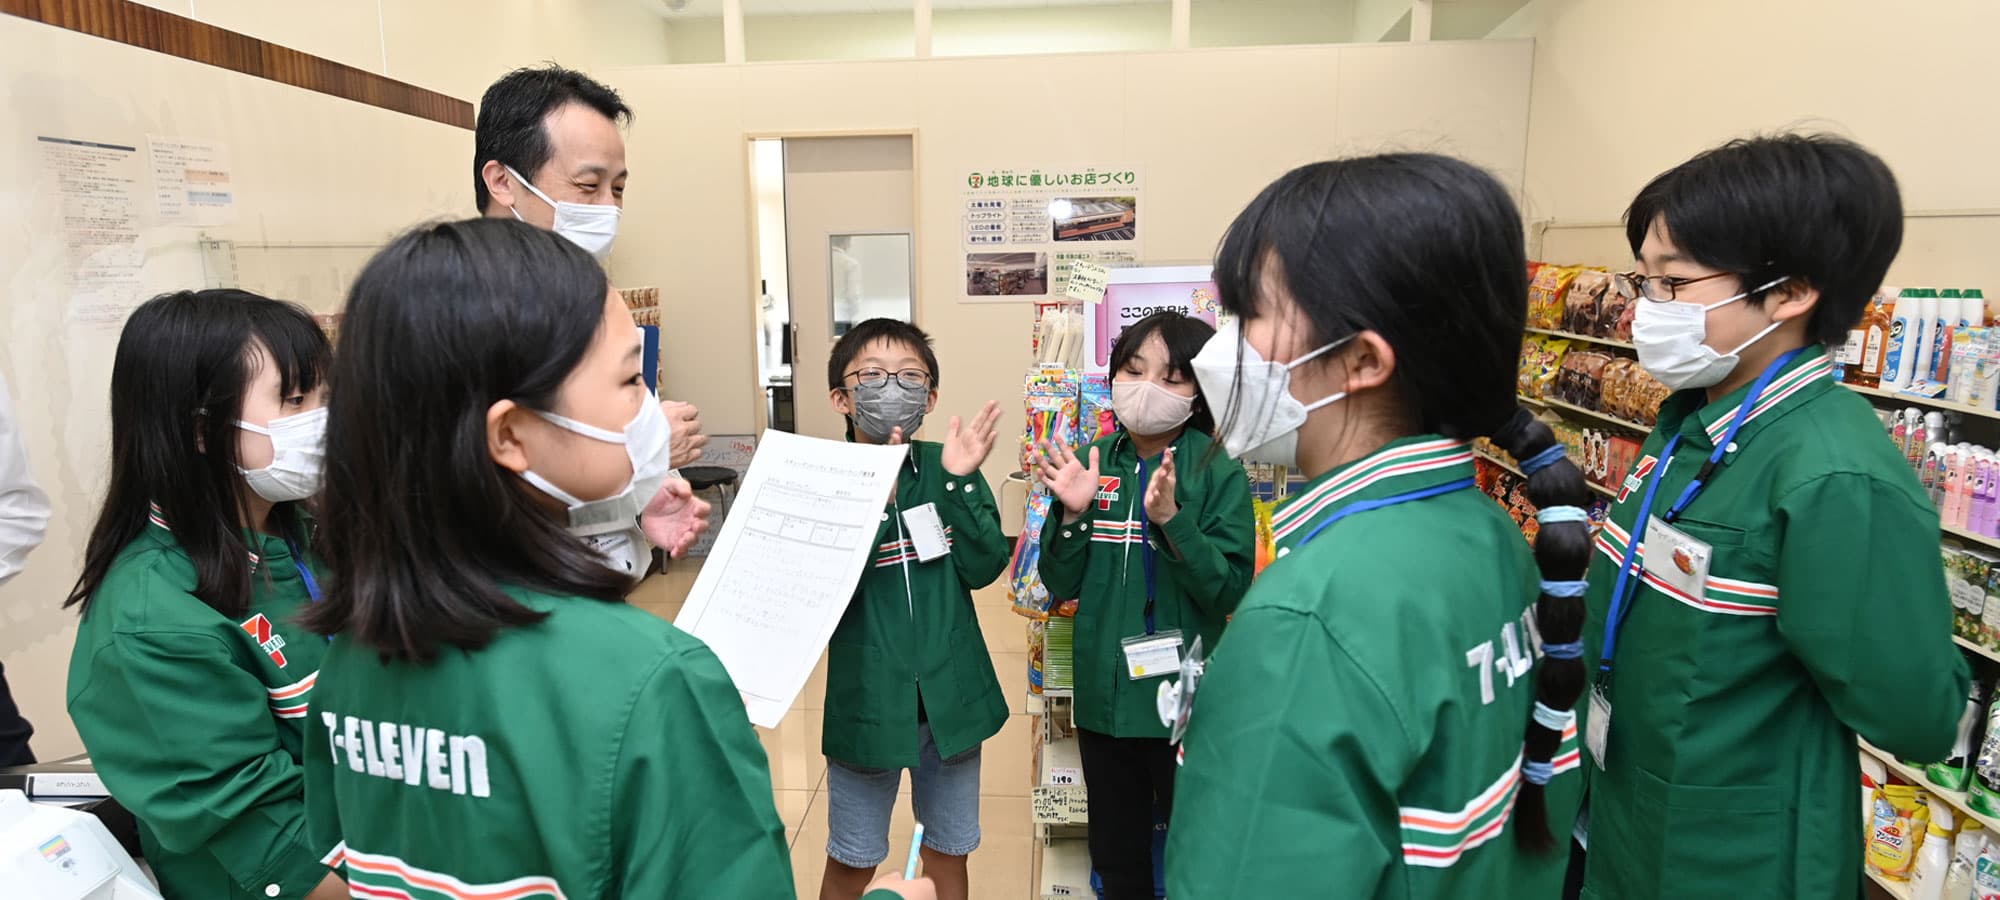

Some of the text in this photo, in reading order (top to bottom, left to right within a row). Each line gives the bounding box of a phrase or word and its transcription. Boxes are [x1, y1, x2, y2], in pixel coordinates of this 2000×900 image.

[987, 172, 1135, 188] 地球に優しいお店づくり
[240, 613, 287, 668] 7
